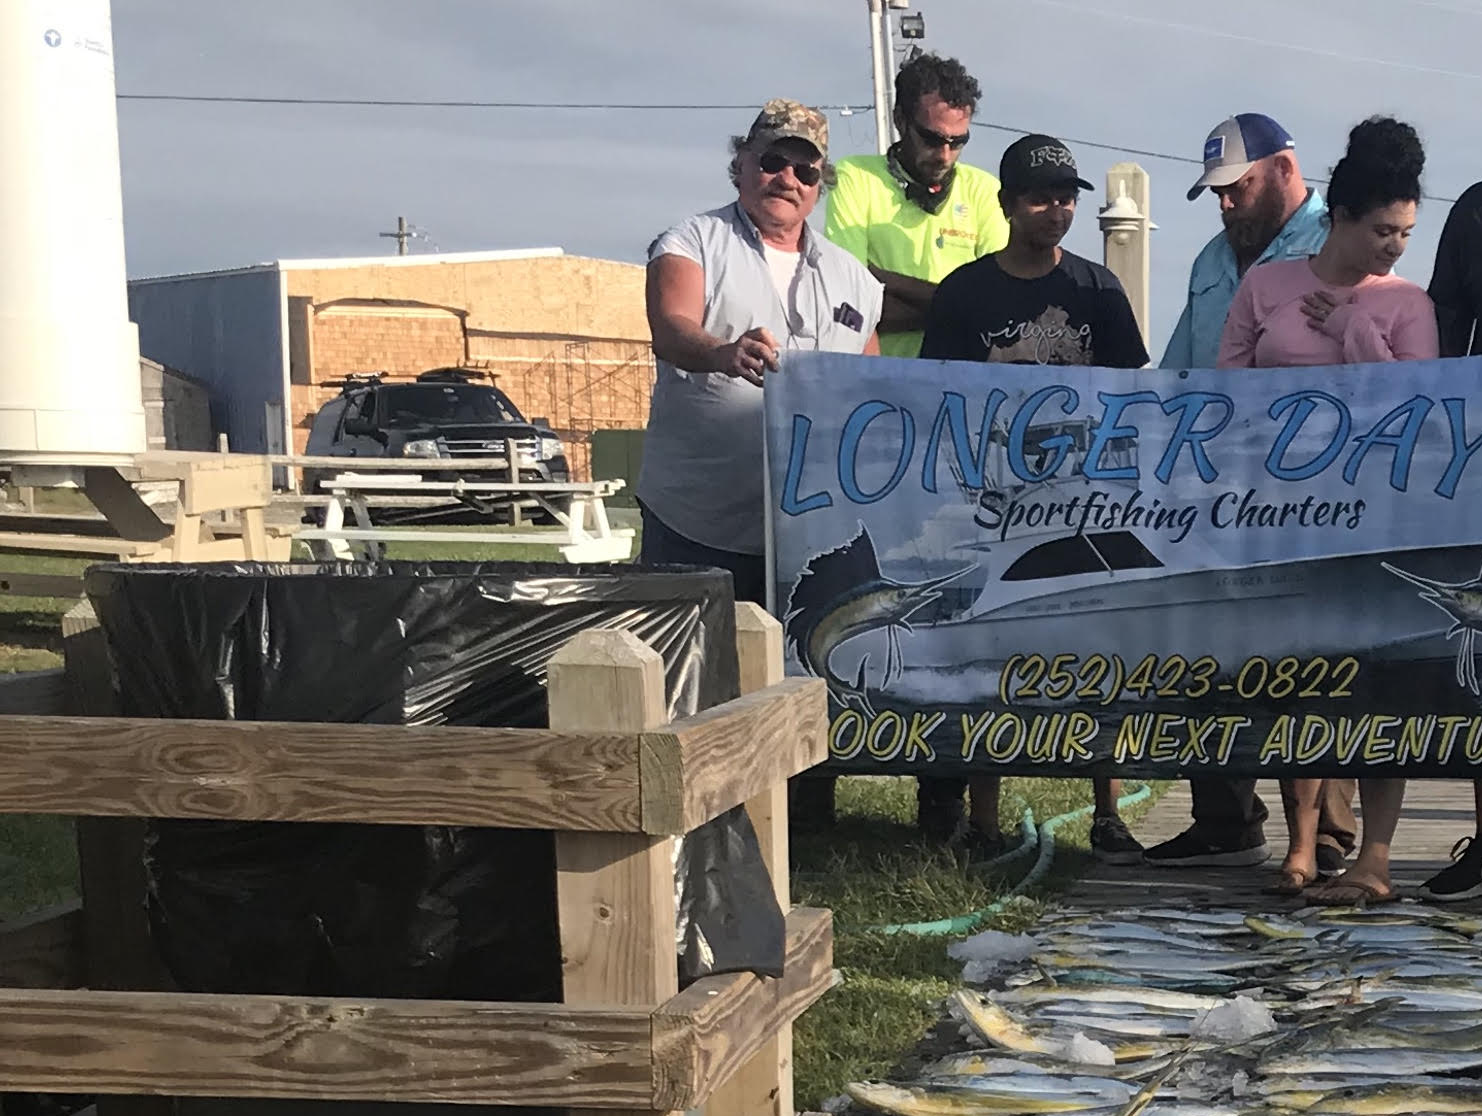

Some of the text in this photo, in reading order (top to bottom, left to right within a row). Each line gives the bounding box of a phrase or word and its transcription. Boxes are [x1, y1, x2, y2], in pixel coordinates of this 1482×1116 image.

[780, 385, 1235, 516] LONGER
[974, 489, 1367, 543] Sportfishing Charters
[1000, 654, 1360, 705] (252)423-0822
[829, 709, 946, 762] OOK
[961, 711, 1100, 763] YOUR
[1113, 712, 1251, 765] NEXT
